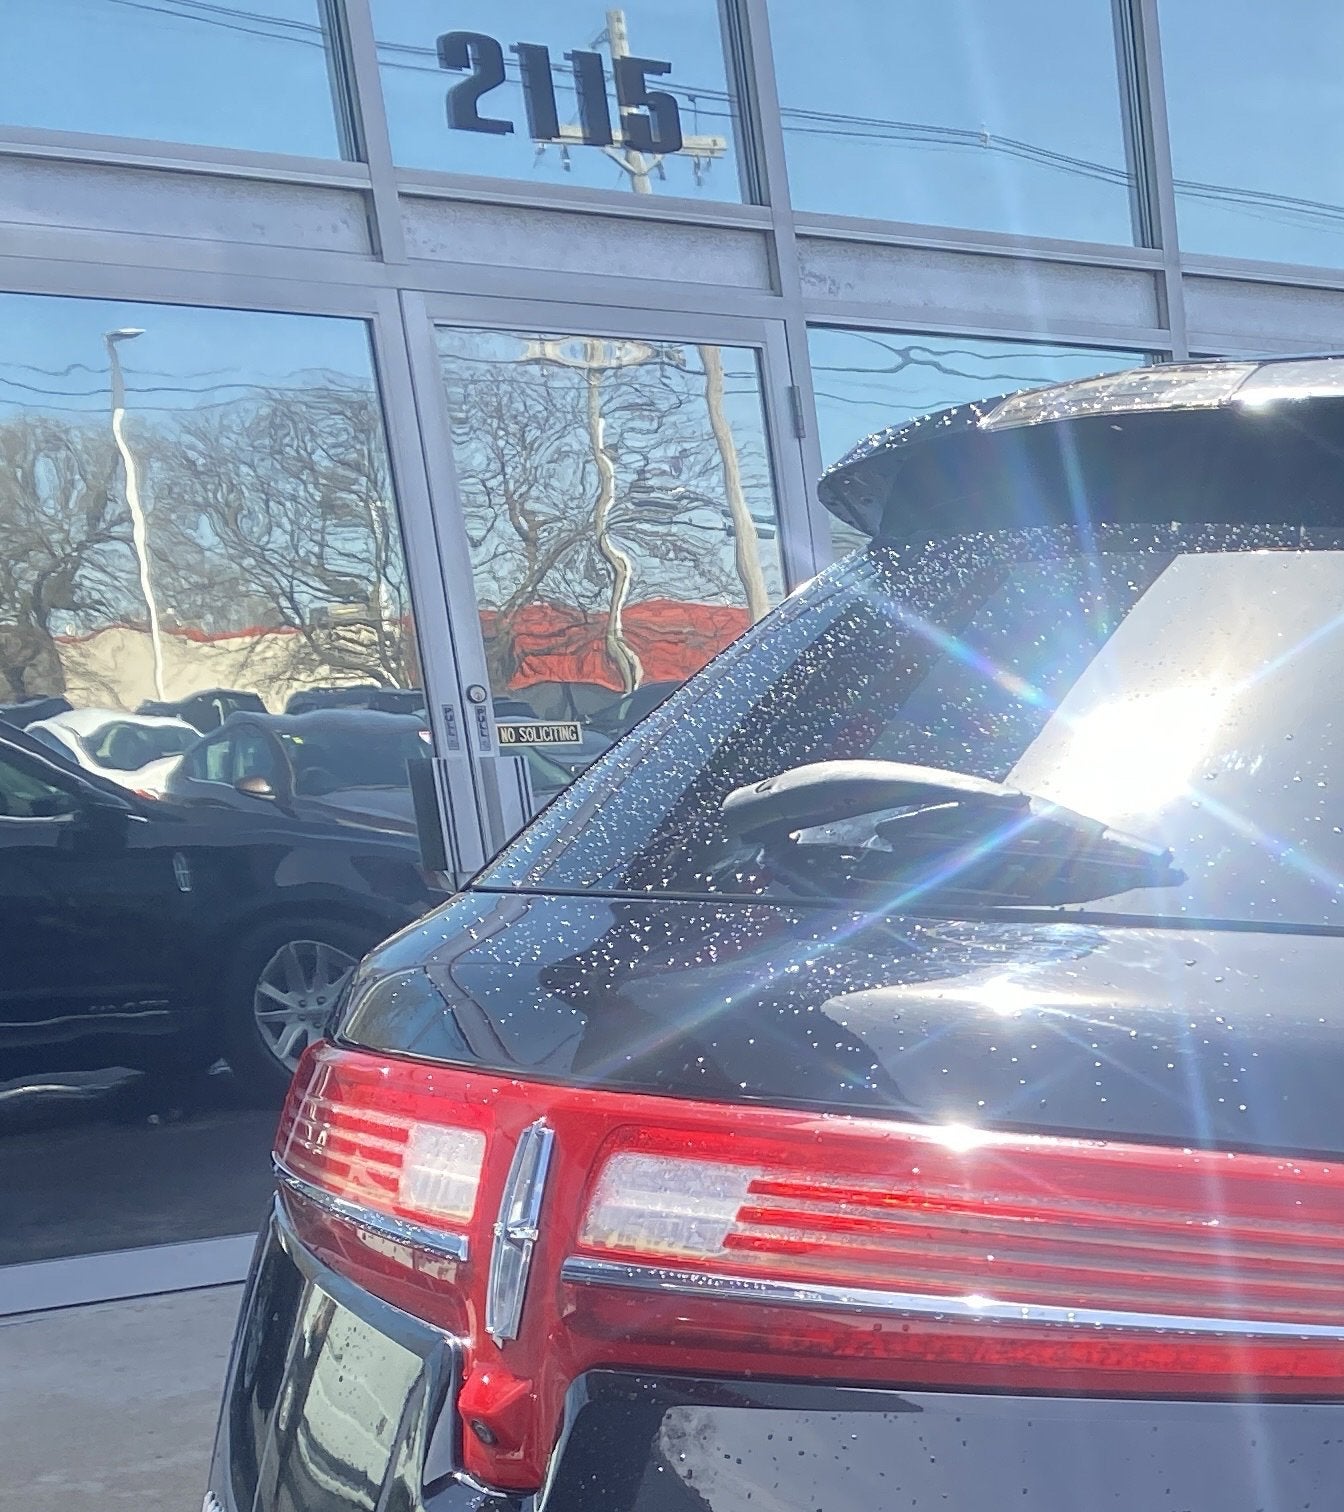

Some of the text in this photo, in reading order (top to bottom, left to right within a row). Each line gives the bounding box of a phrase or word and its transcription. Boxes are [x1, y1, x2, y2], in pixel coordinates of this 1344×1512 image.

[437, 31, 682, 153] 2115
[500, 725, 578, 743] NO SOLICITING
